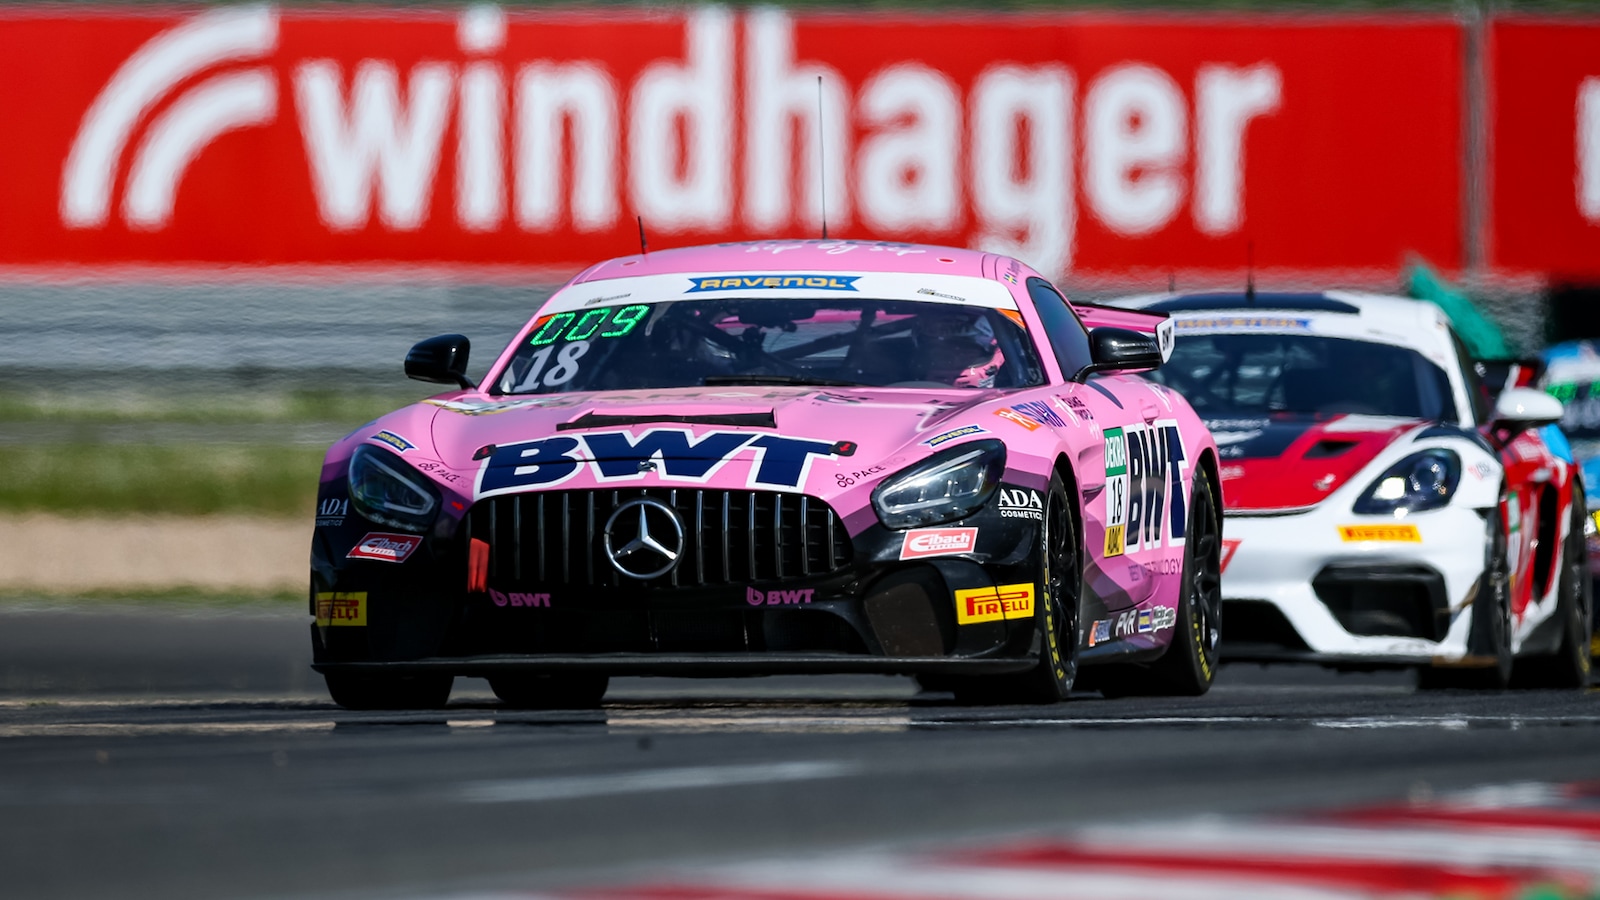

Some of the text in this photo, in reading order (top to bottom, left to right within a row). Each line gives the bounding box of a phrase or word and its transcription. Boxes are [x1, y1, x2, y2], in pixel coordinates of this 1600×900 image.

[293, 3, 1283, 282] windhager
[700, 277, 847, 289] RAVENOL
[530, 304, 650, 346] 009
[512, 340, 590, 393] 18
[476, 429, 838, 496] BWT
[1105, 435, 1126, 469] DEKRA
[998, 488, 1043, 509] ADA
[1125, 421, 1187, 551] BWT
[317, 497, 349, 516] ADA
[1112, 478, 1123, 524] 18
[359, 537, 412, 556] Eibach
[909, 532, 971, 552] Eibach
[1107, 526, 1121, 554] ADAC
[508, 592, 551, 608] BWT
[766, 588, 815, 606] BWT
[965, 591, 1029, 617] PIRELLI
[1115, 609, 1138, 637] PVR
